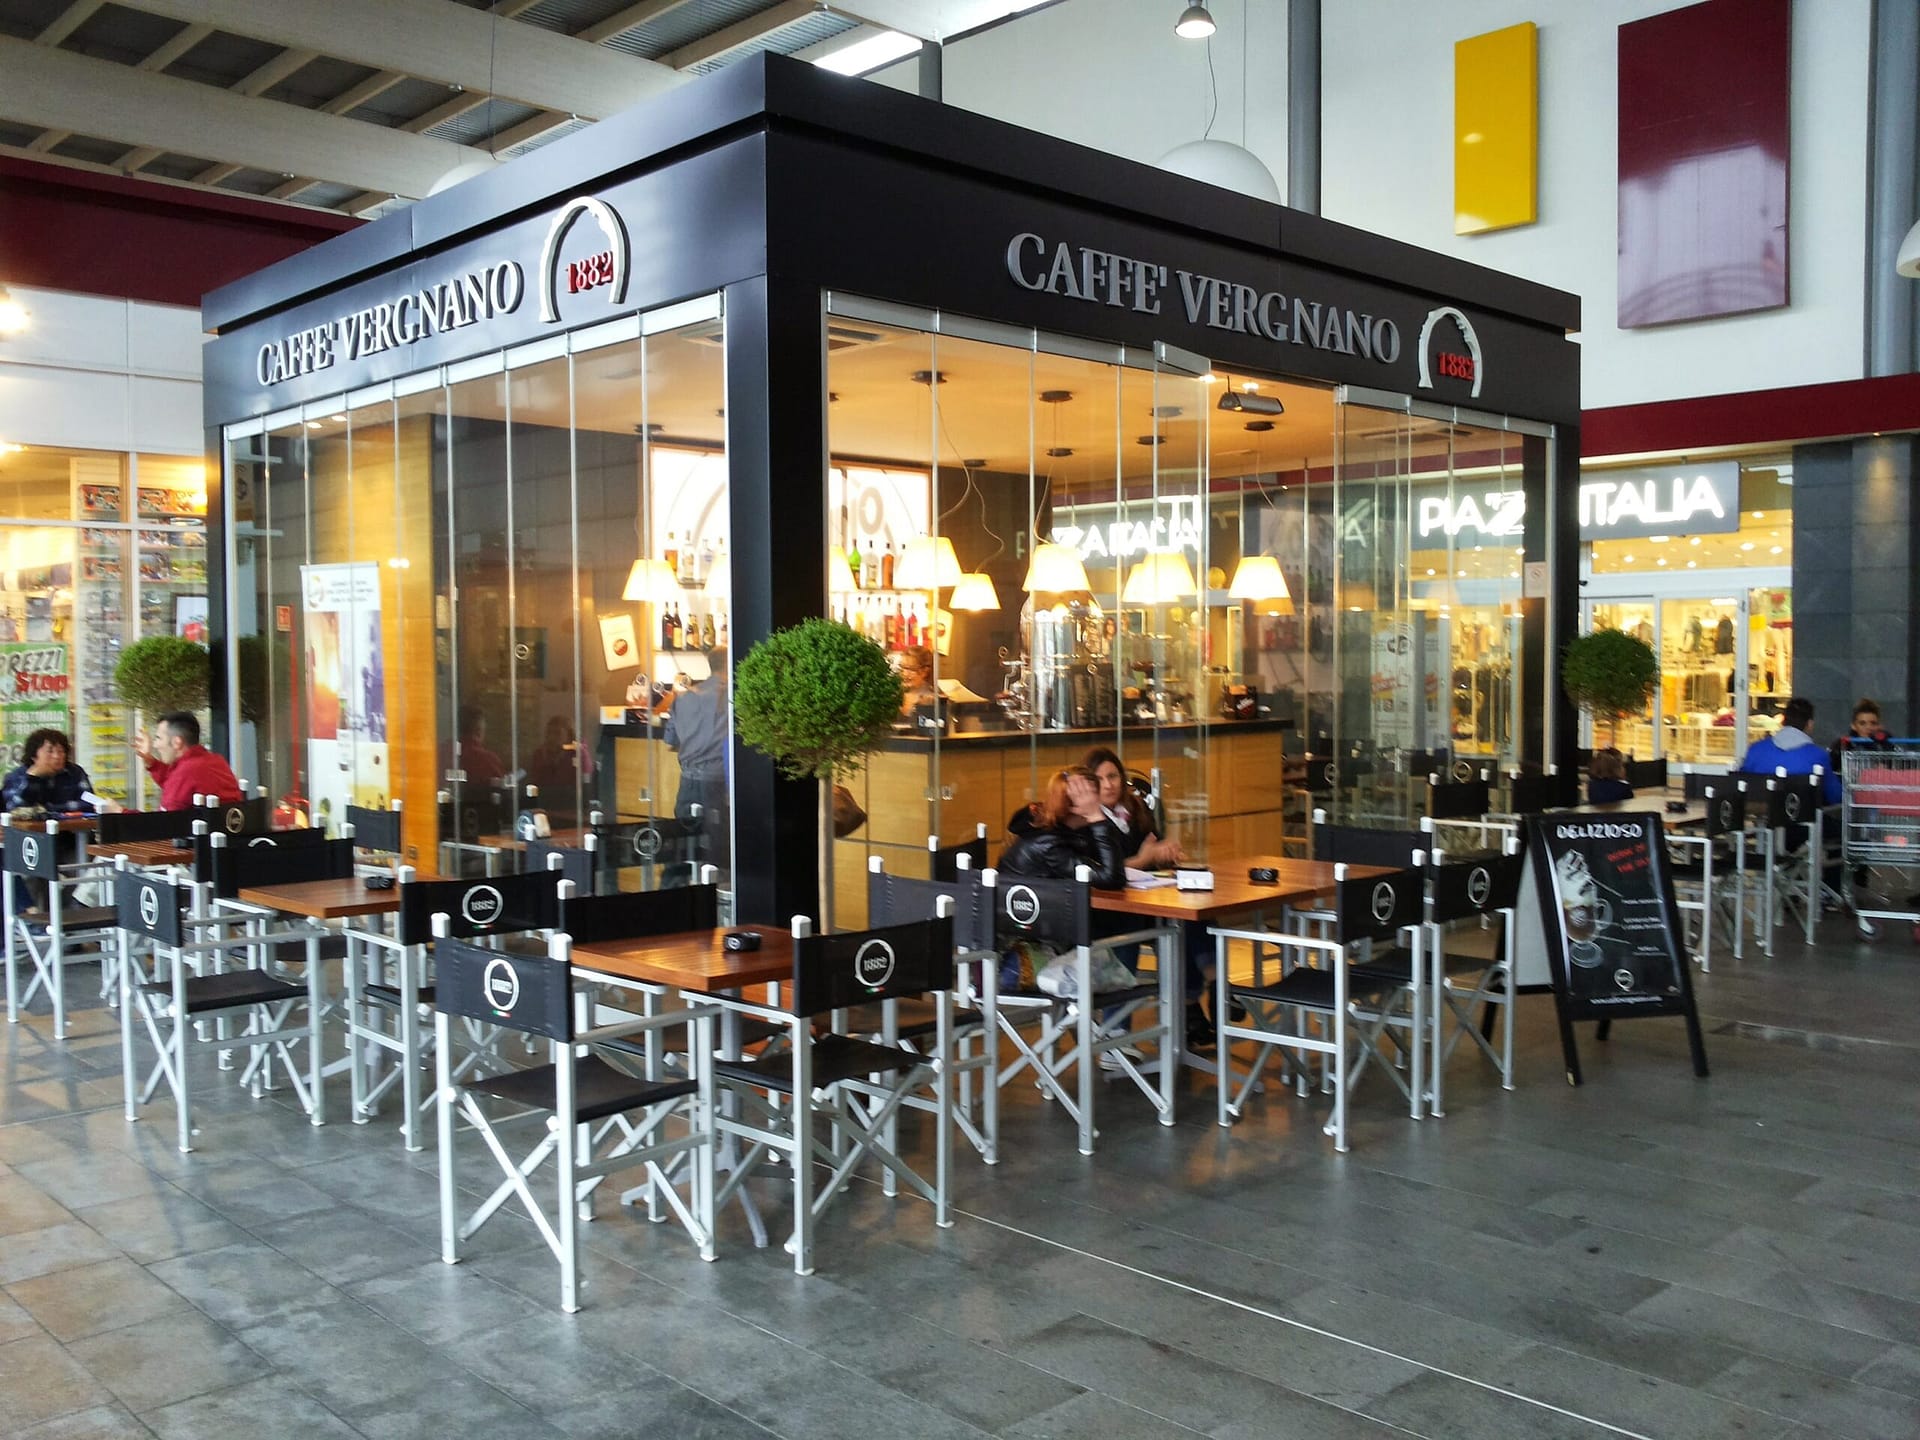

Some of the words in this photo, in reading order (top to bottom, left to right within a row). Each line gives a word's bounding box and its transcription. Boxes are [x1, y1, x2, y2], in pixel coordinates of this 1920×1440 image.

[565, 249, 614, 294] 1882
[256, 323, 339, 387] CAFFE'
[338, 259, 525, 361] VERGNANO
[1006, 232, 1167, 316] CAFFE'
[1176, 269, 1401, 365] VERGNANO
[1438, 351, 1475, 382] 1882
[1419, 489, 1526, 537] PIAZ
[1579, 475, 1725, 527] ITALIA
[1556, 822, 1644, 839] DELIZIOSO
